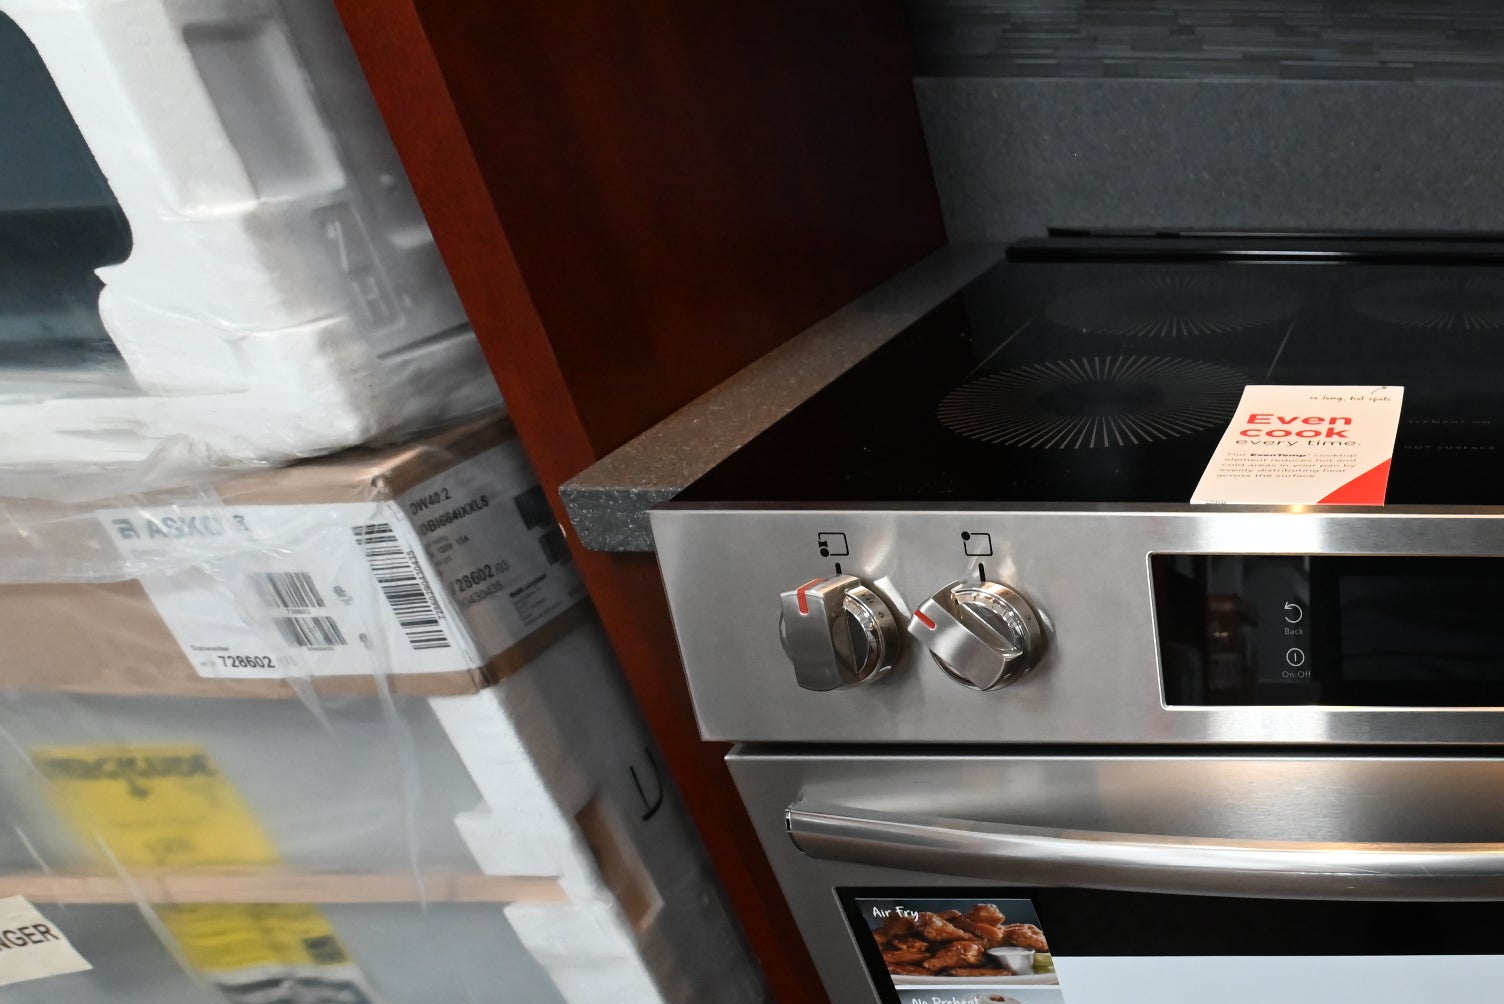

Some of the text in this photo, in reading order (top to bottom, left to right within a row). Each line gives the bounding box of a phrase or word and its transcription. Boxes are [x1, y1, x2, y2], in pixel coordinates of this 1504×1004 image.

[1247, 413, 1352, 425] Even
[1239, 426, 1349, 438] cook
[1235, 439, 1299, 447] every
[145, 515, 224, 539] ASKO
[1284, 627, 1304, 635] Back
[218, 655, 276, 669] 728602
[872, 905, 919, 922] Air Fry
